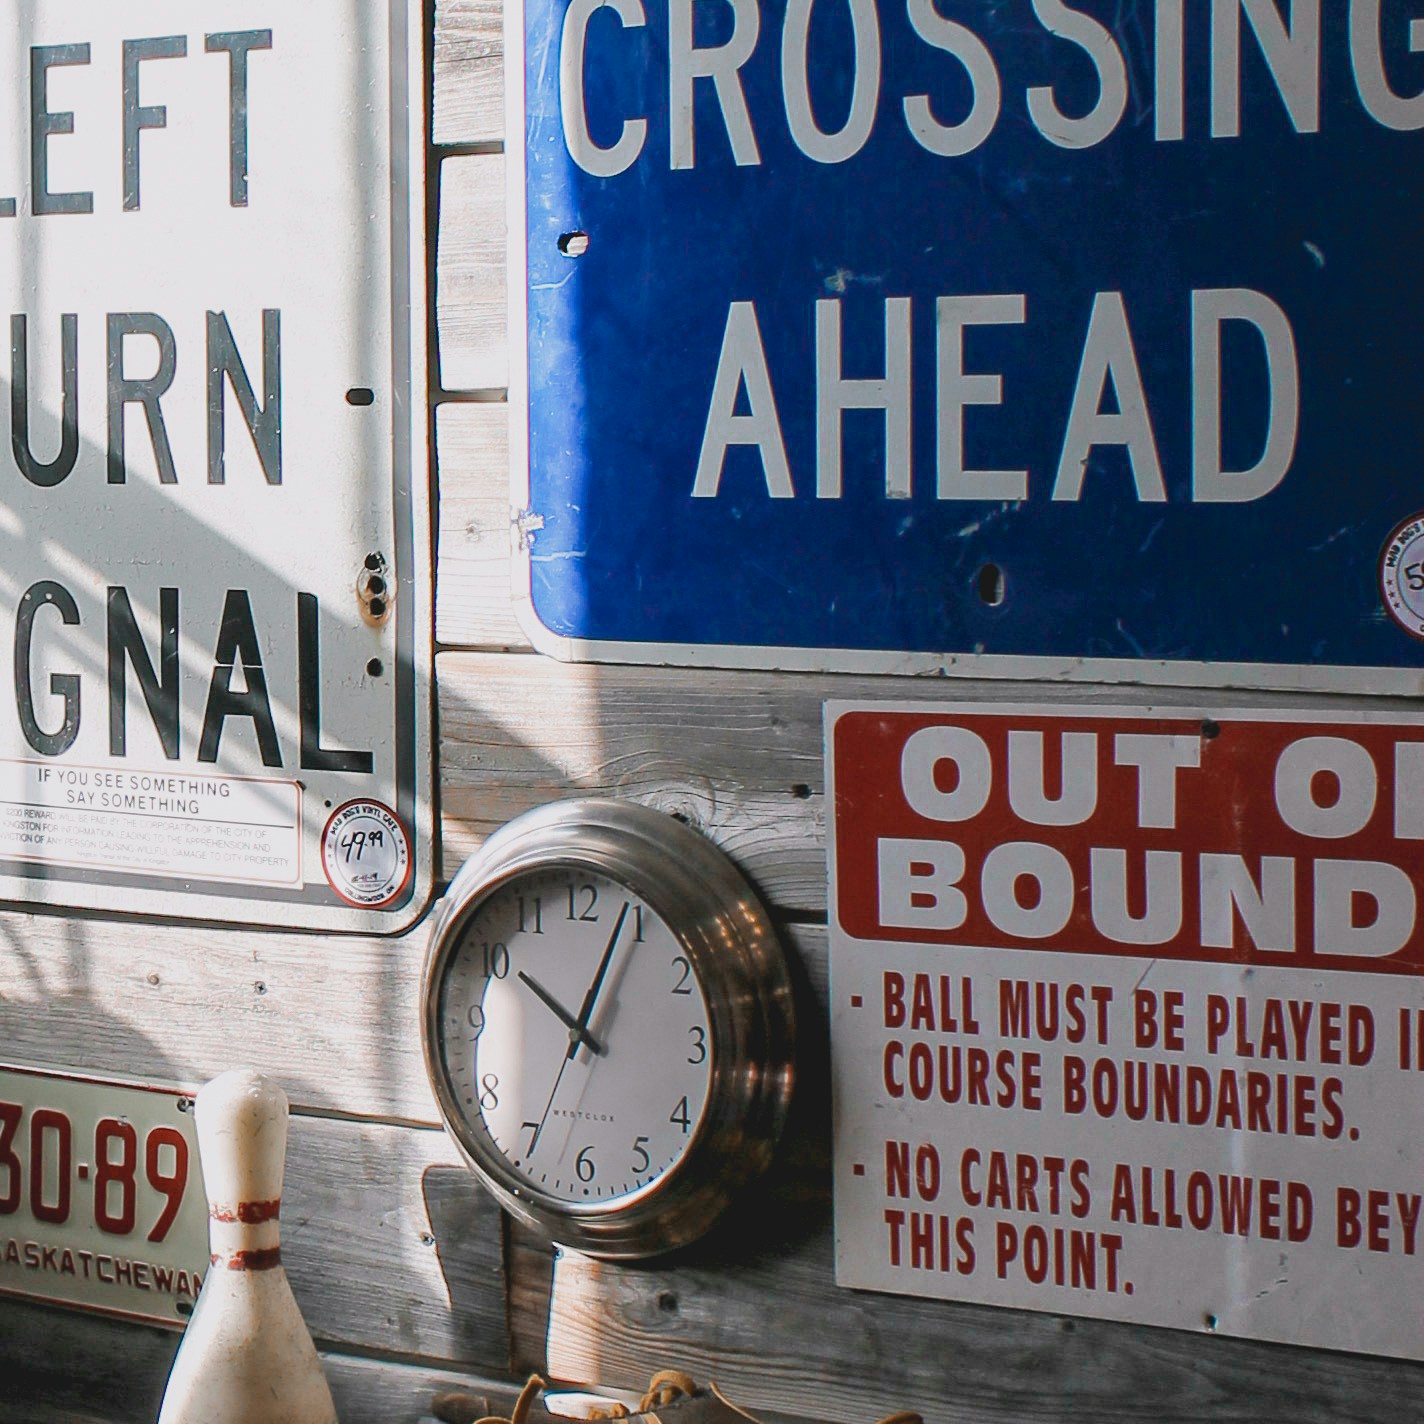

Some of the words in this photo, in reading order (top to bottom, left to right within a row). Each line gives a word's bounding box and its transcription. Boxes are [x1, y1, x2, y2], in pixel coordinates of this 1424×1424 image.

[690, 286, 1301, 504] AHEAD
[38, 767, 52, 784] IF
[57, 770, 88, 787] YOU
[94, 772, 124, 789] SEE
[129, 775, 232, 798] SOMETHING
[66, 789, 95, 805] SAY
[101, 792, 201, 815] SOMETHING
[900, 725, 1202, 830] OUT
[23, 808, 56, 821] REWARD
[139, 818, 200, 835] CORPORATION
[201, 824, 214, 835] OF
[215, 825, 232, 837] THE
[234, 827, 254, 839] CITY
[254, 829, 268, 840] OF
[33, 833, 45, 845] OF
[46, 834, 63, 846] ANY
[64, 837, 97, 851] PERSON
[98, 841, 135, 855] CAUSING
[171, 847, 208, 861] DAMAGE
[209, 851, 222, 861] TO
[223, 852, 244, 864] CITY
[245, 854, 290, 868] PROPERTY
[42, 821, 60, 834] FOR
[116, 828, 151, 842] LEADING
[153, 832, 165, 842] TO
[166, 833, 182, 845] THE
[252, 842, 271, 853] AND
[516, 896, 545, 935] 11
[564, 883, 600, 923] 12
[632, 904, 646, 943] 1
[479, 942, 510, 980] 10
[670, 956, 693, 995] 2
[466, 1004, 486, 1042] 9
[687, 1026, 707, 1065] 3
[884, 970, 980, 1036] BALL
[999, 978, 1115, 1046] MUST
[1133, 988, 1185, 1053] BE
[1207, 994, 1376, 1068] PLAYED
[1399, 1007, 1424, 1073] I
[479, 1073, 500, 1111] 8
[669, 1094, 692, 1133] 4
[552, 1108, 616, 1124] WESTCLOX
[884, 1040, 1043, 1112] COURSE
[1063, 1055, 1361, 1142] BOUNDARIES.
[521, 1121, 541, 1159] 7
[631, 1136, 651, 1173] 5
[575, 1145, 596, 1183] 6
[885, 1140, 942, 1204] NO
[960, 1147, 1092, 1219] CARTS
[1110, 1162, 1314, 1244] ALLOWED
[885, 1209, 976, 1277] THIS
[997, 1222, 1135, 1296] POINT.
